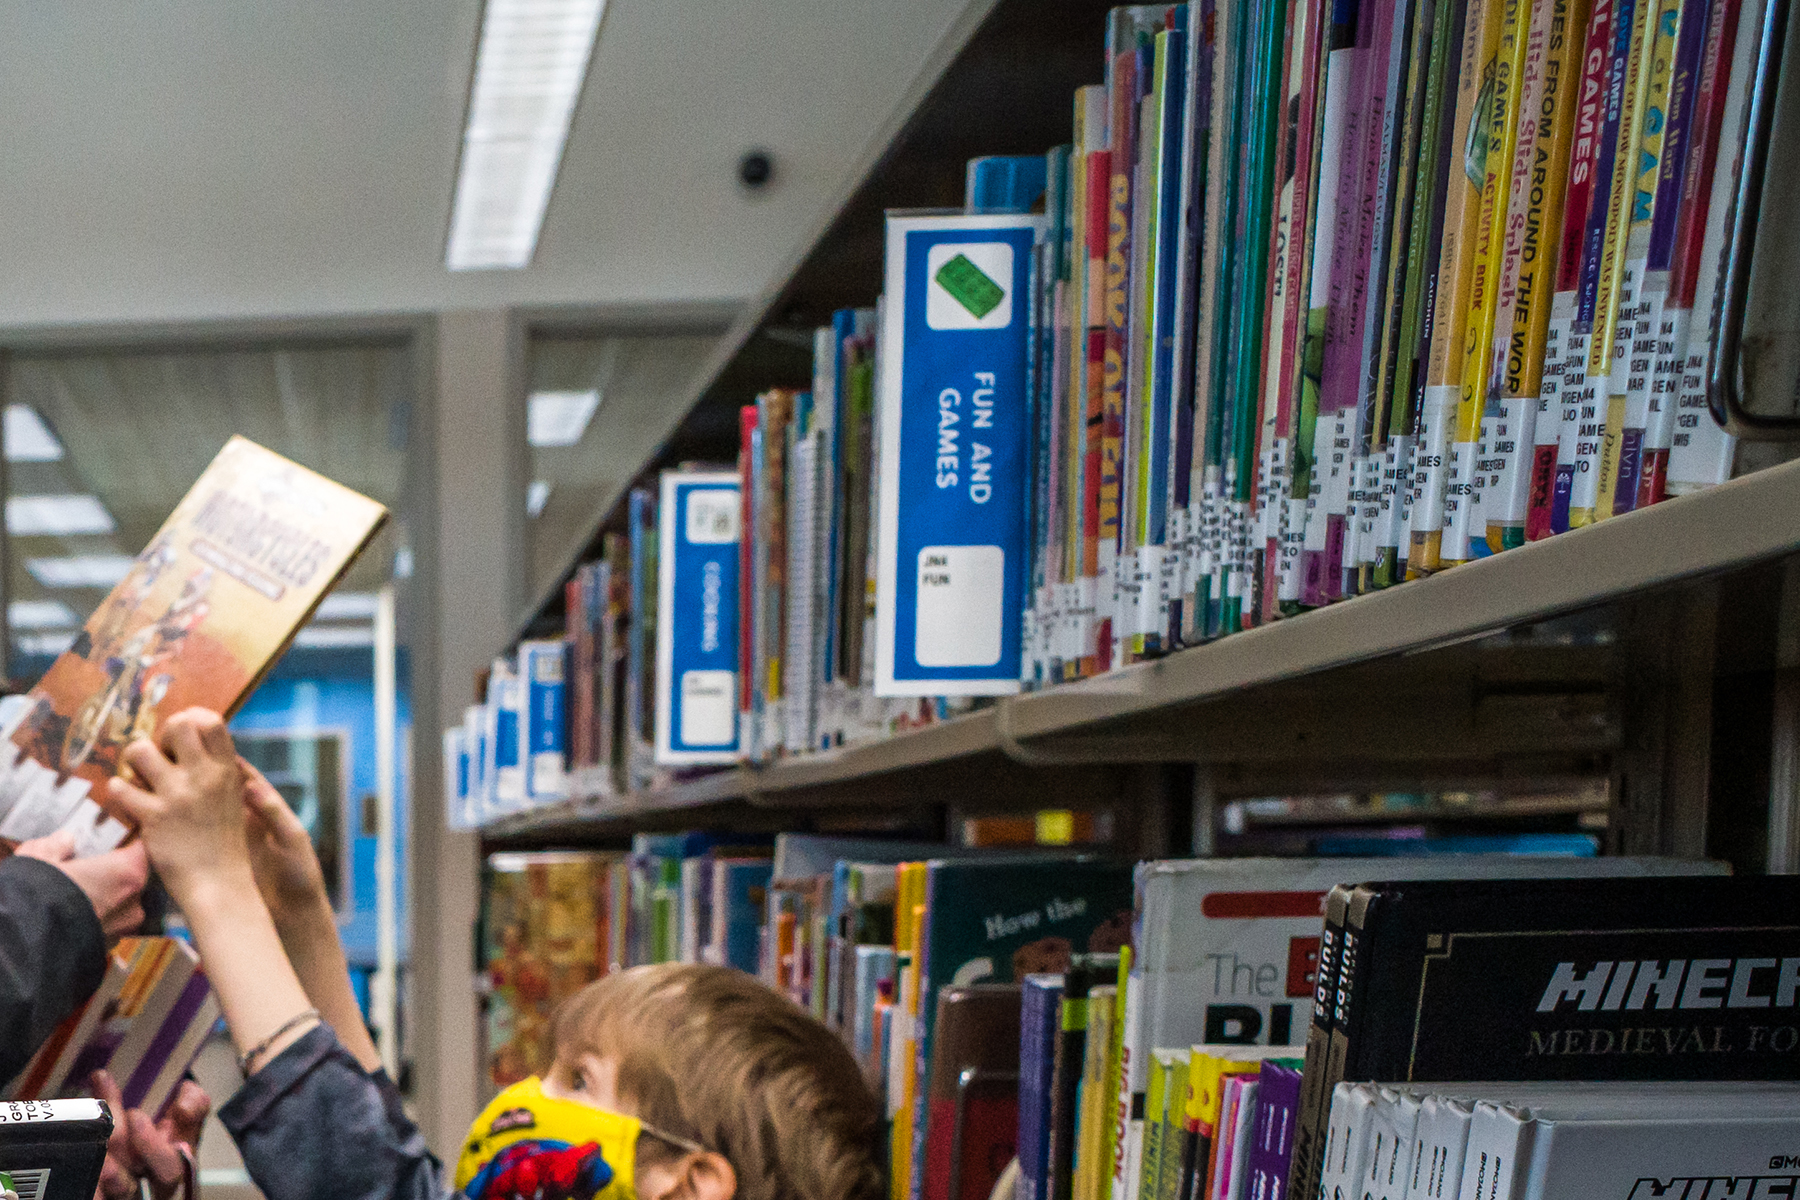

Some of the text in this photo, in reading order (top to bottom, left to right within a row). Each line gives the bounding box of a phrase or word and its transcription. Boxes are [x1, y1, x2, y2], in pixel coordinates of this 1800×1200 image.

[1608, 5, 1630, 122] LOVE GAMES
[1573, 49, 1603, 185] GAMES
[1472, 61, 1510, 310] GAMES ACTIVITY BOOK
[1501, 30, 1543, 307] Hide Slide Splash
[1593, 33, 1643, 365] STORY OF HOW MONOPOLY WAS INVENTED
[1358, 194, 1374, 259] Make
[1409, 171, 1425, 268] ACTIVITIES
[1505, 60, 1560, 393] FROM AROUND THE WOR
[1349, 269, 1365, 336] Them
[1683, 376, 1699, 388] FUN
[935, 387, 962, 489] GAMES
[970, 371, 996, 505] FUN AND
[985, 898, 1087, 940] How the
[1205, 952, 1279, 999] The
[1314, 929, 1334, 1018] BUILDS
[1334, 931, 1354, 1021] BUILDS
[1525, 1024, 1800, 1058] MEDIEVAL FO
